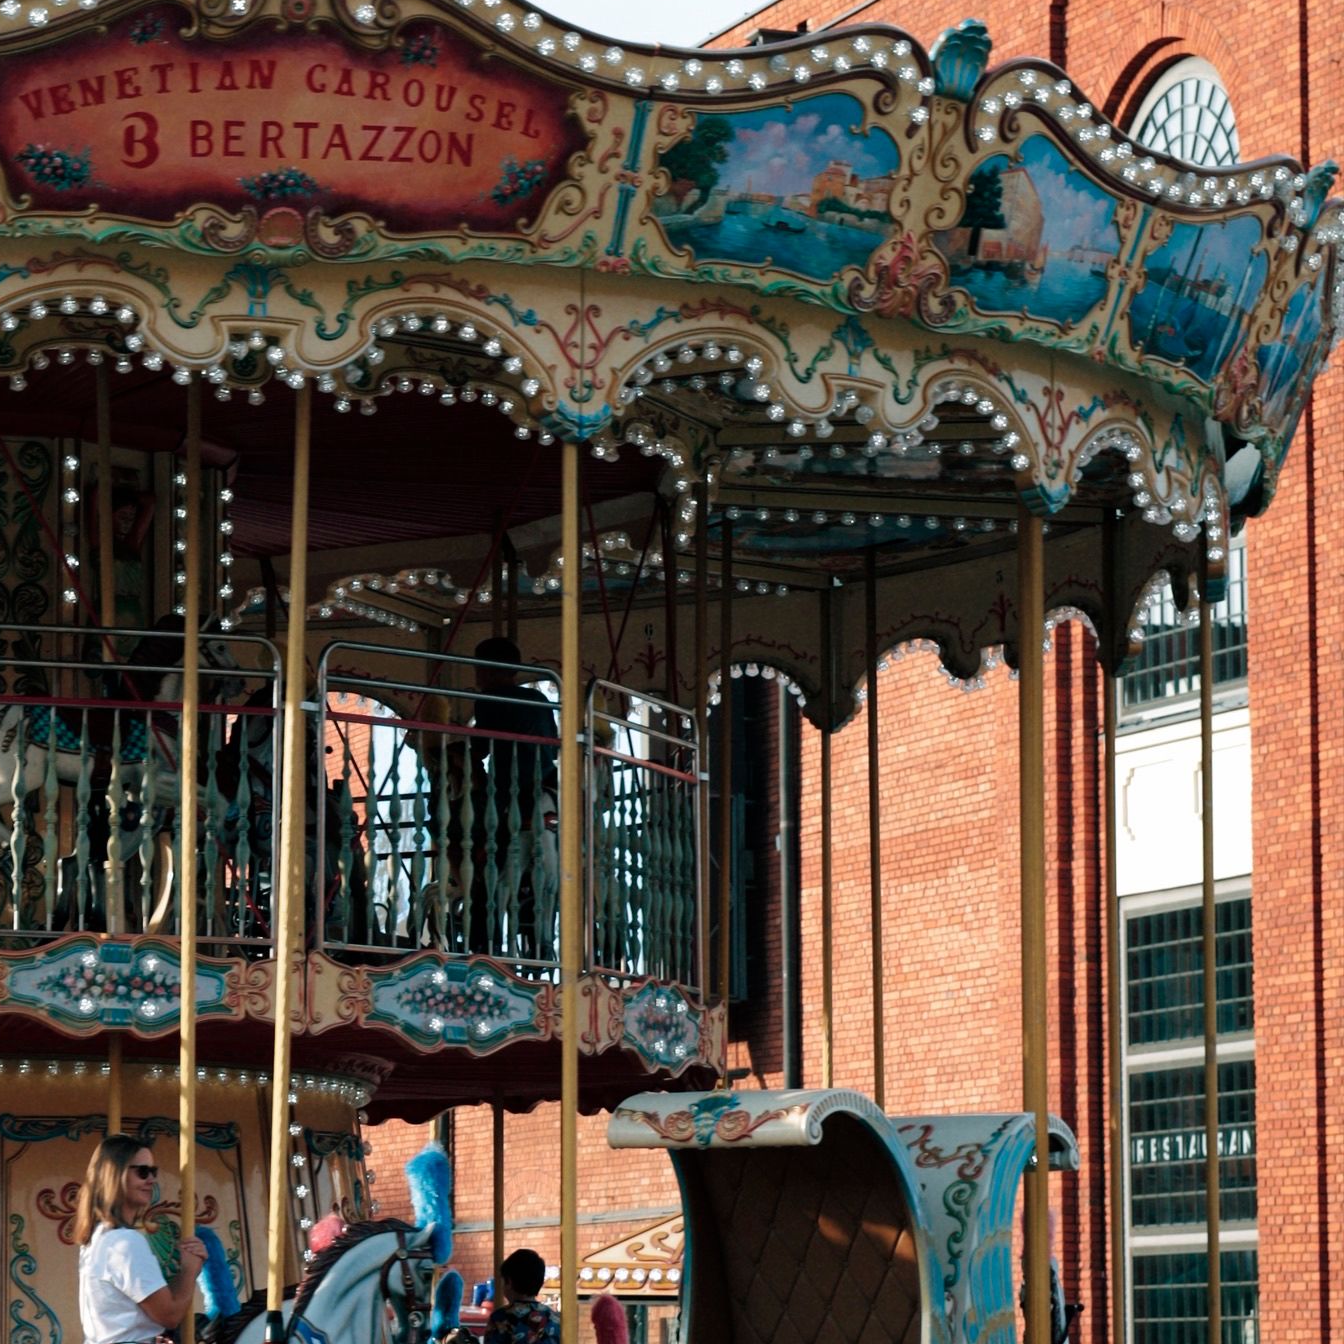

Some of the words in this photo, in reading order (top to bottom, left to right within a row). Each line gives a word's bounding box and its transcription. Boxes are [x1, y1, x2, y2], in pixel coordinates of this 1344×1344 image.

[19, 59, 277, 122] VENETIAN
[306, 62, 542, 140] CAROUSEL
[189, 120, 476, 168] BERTAZZON
